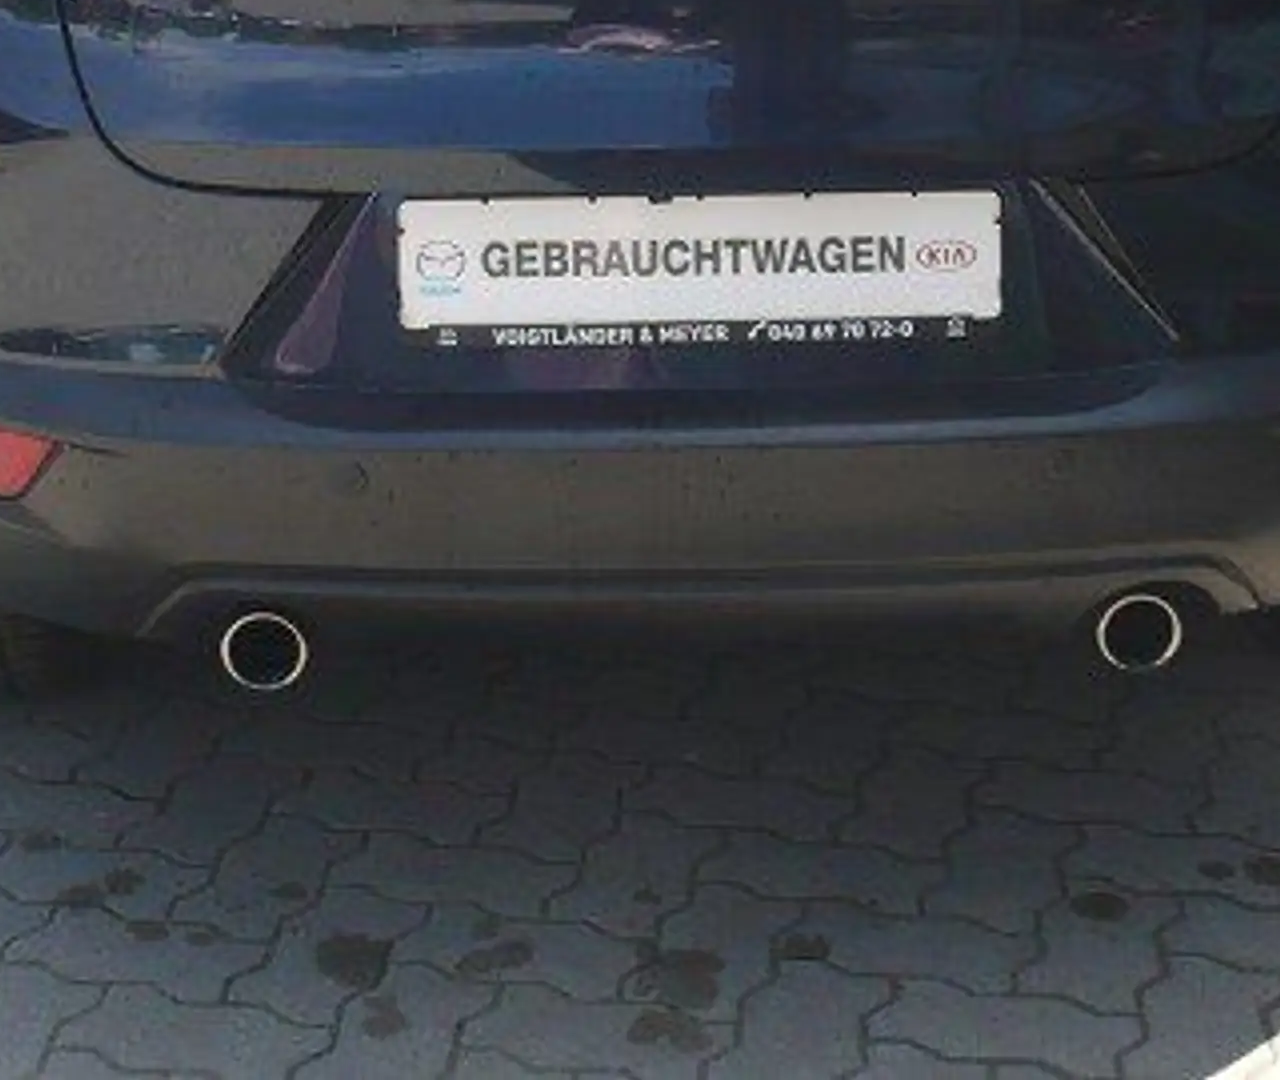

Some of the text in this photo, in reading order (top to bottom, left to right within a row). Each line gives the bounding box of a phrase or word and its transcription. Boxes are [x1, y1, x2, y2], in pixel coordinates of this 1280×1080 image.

[481, 235, 906, 280] GEBRAUCHTWAGEN
[925, 245, 968, 267] KIA
[639, 325, 654, 344] &
[659, 323, 730, 344] MEYER
